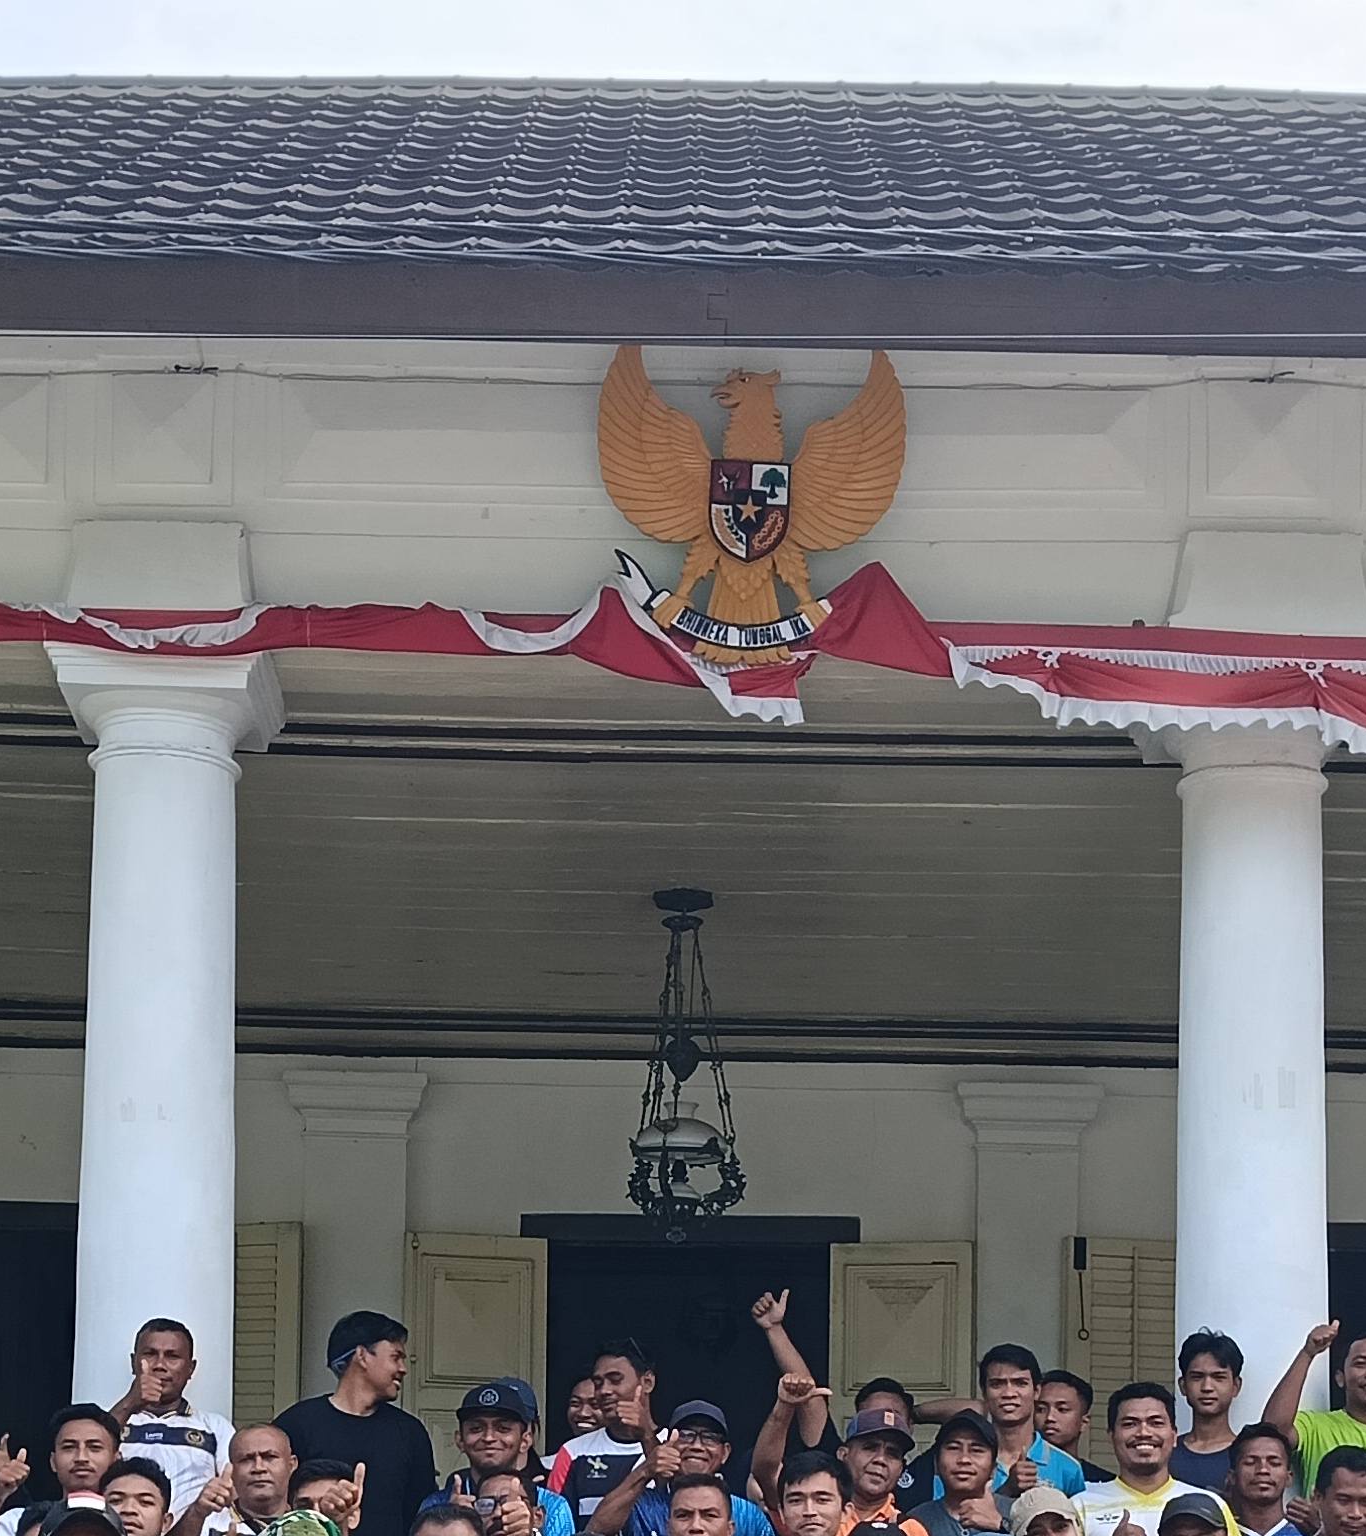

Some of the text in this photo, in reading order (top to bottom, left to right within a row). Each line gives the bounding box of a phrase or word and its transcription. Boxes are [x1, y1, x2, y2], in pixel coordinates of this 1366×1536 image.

[676, 609, 811, 646] BHINNEKA TUNGGAL IKA
